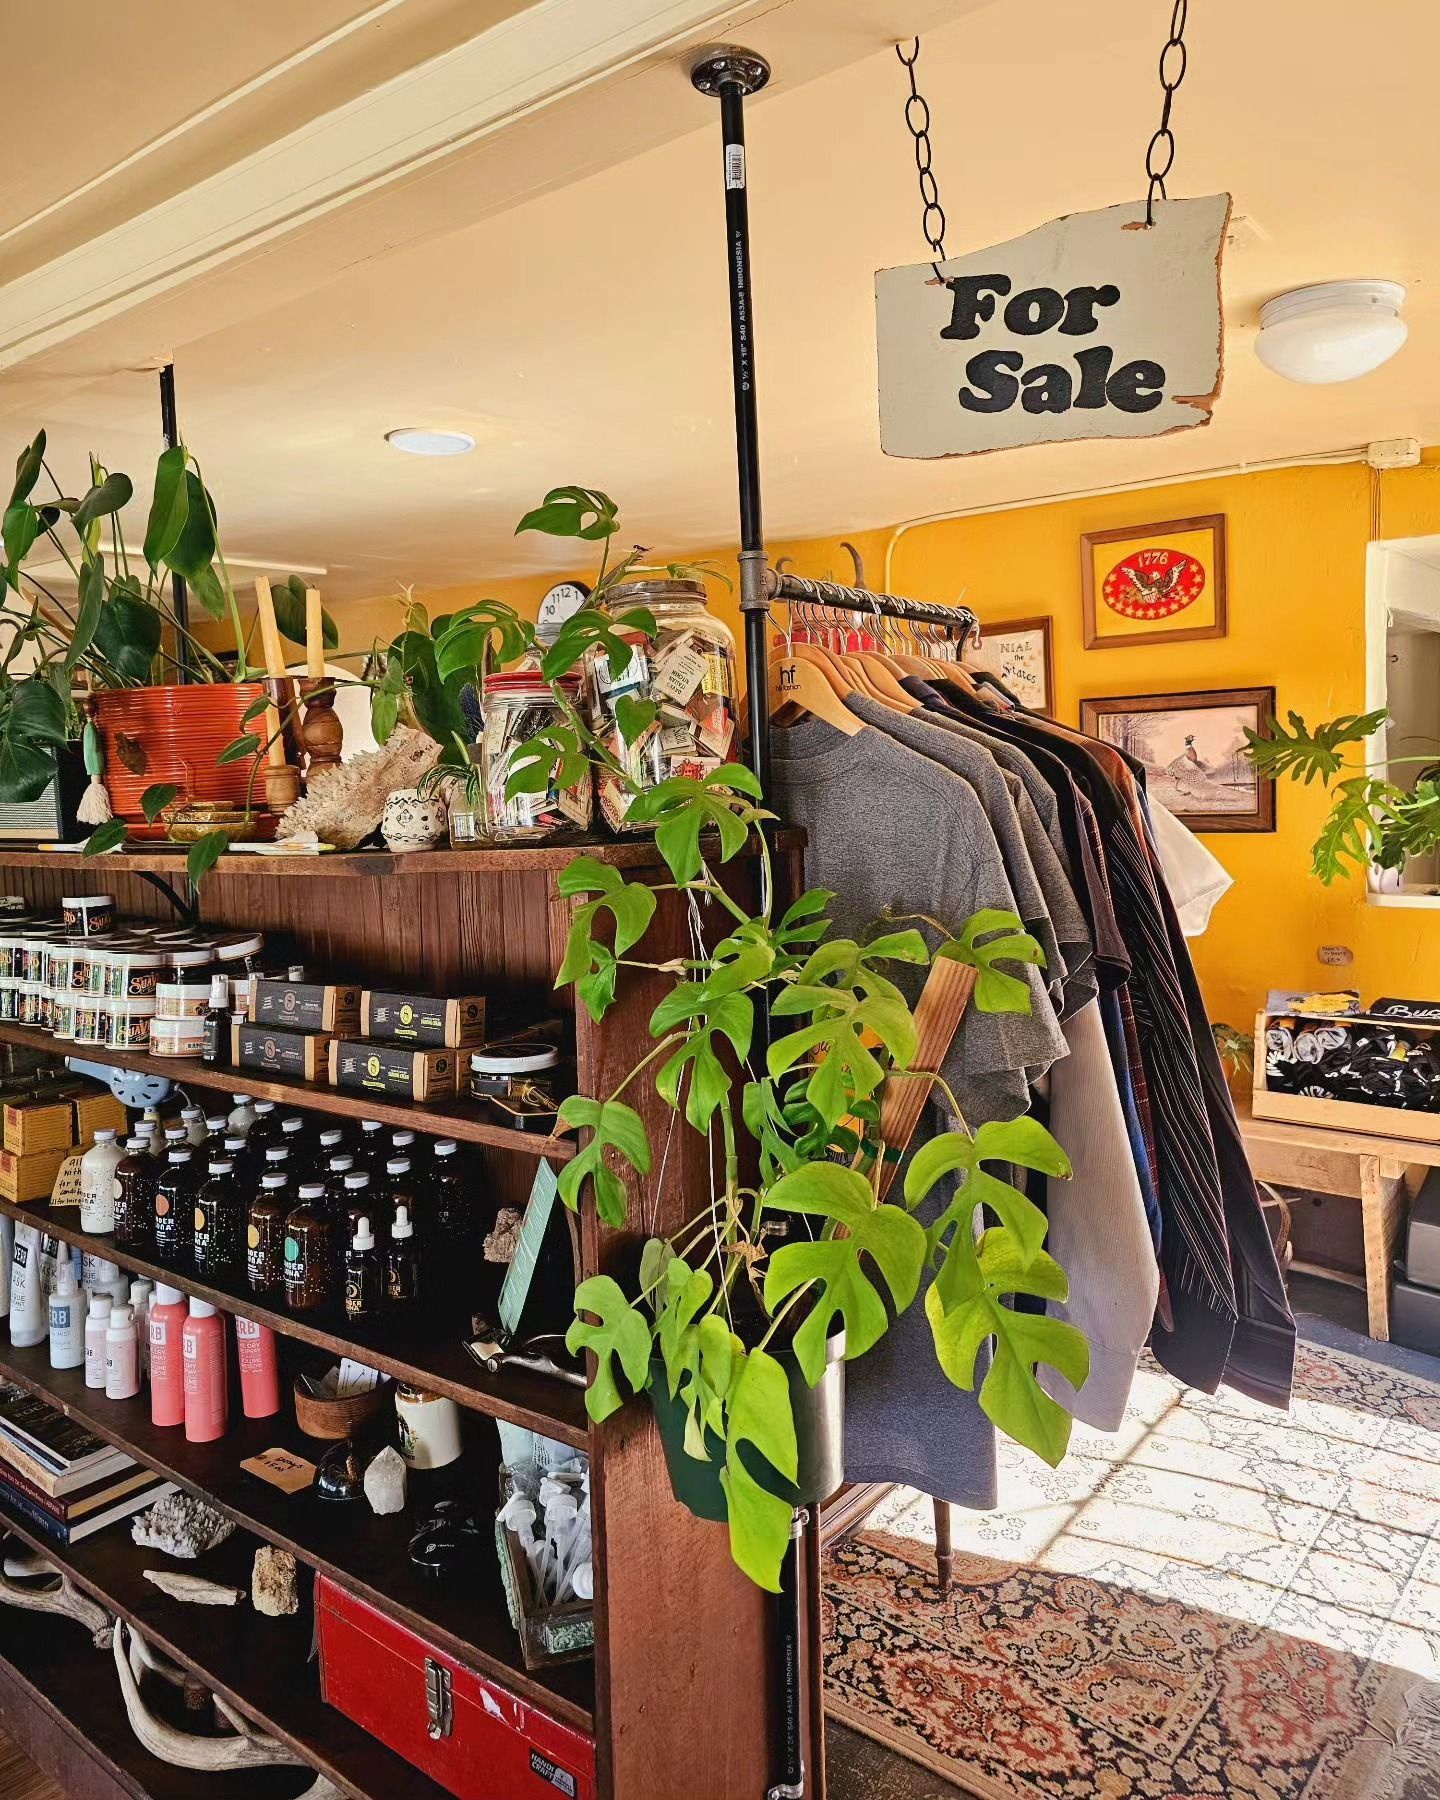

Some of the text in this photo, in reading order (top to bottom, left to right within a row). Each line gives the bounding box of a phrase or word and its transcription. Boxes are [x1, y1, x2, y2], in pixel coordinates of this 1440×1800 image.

[735, 240, 744, 289] INDONESIA
[939, 273, 1121, 340] For
[958, 345, 1166, 414] Sale
[1137, 551, 1169, 568] 1776
[552, 593, 560, 603] 11
[561, 587, 571, 598] 12
[574, 590, 578, 601] 1
[545, 604, 556, 616] 10
[779, 664, 796, 685] hf
[1001, 661, 1036, 684] States
[531, 1753, 555, 1772] HANDI
[531, 1761, 554, 1779] CRAFT
